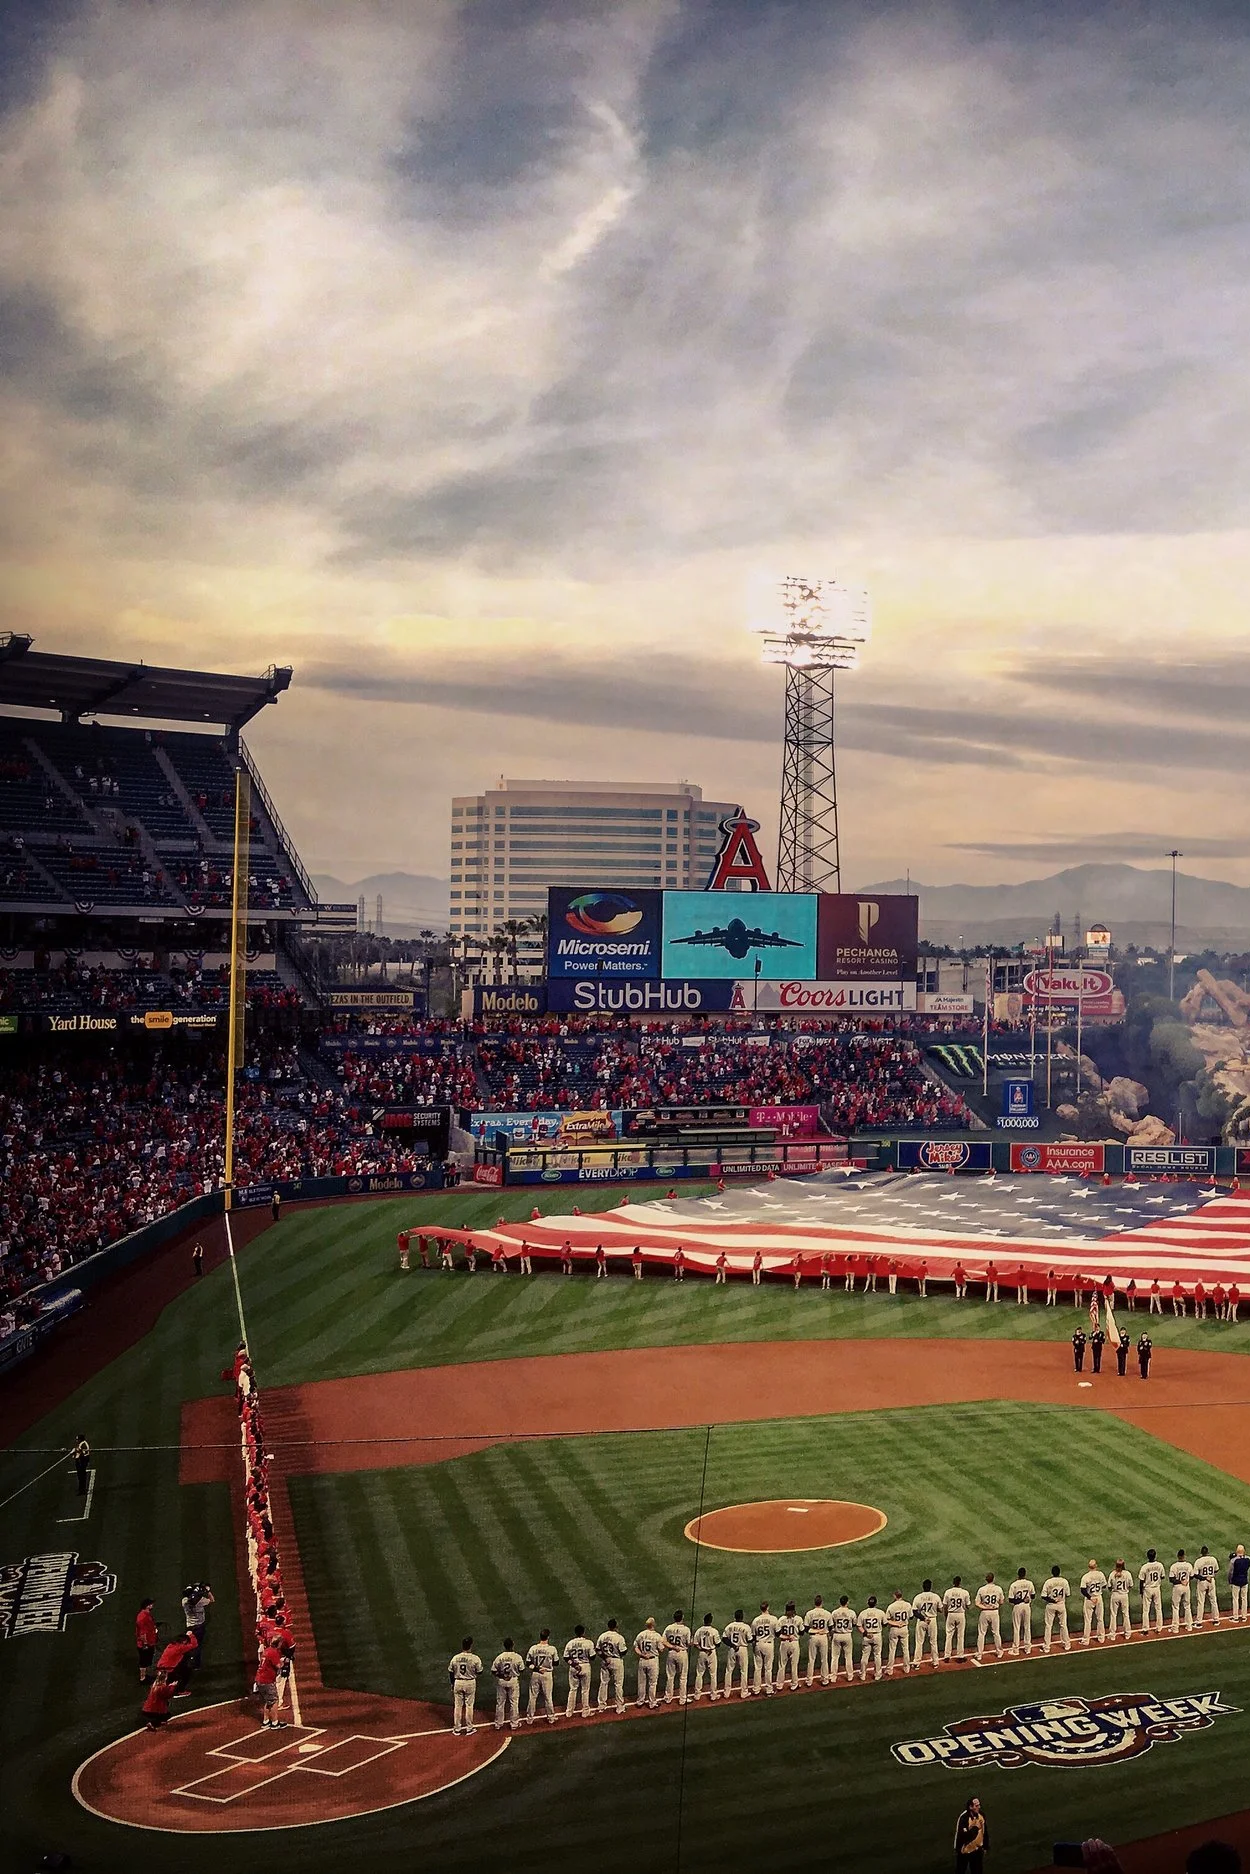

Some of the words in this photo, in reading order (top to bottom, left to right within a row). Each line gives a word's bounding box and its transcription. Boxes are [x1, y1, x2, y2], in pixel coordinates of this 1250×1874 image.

[836, 948, 898, 958] PECHANGA
[564, 960, 598, 970] Power
[1041, 977, 1099, 990] Yakult
[350, 995, 359, 1004] IN
[361, 995, 374, 1004] THE
[376, 995, 410, 1004] OUTFIELD
[574, 981, 702, 1009] StubHub
[780, 982, 847, 1007] Coors
[849, 989, 904, 1006] LIGHT
[482, 991, 538, 1011] Modelo
[49, 1015, 77, 1031] Yard
[80, 1016, 117, 1030] House
[130, 1015, 145, 1024] the
[148, 1014, 169, 1024] smile
[173, 1015, 216, 1026] generation
[997, 1119, 1039, 1129] $1,000,000
[926, 1142, 963, 1153] Jersey
[1046, 1146, 1094, 1157] Insurance
[722, 1164, 761, 1172] UNLIMITED
[783, 1162, 818, 1171] UNLIMITE
[1046, 1159, 1094, 1169] AAA.com
[369, 1177, 402, 1190] Modelo
[1202, 1565, 1214, 1575] 89
[1149, 1572, 1158, 1581] 18
[1090, 1583, 1101, 1593] 25
[1116, 1580, 1126, 1590] 21
[1052, 1588, 1064, 1598] 34
[949, 1598, 961, 1609] 39
[984, 1595, 997, 1605] 38
[921, 1603, 933, 1613] 47
[895, 1611, 907, 1621] 50
[812, 1619, 825, 1629] 58
[836, 1619, 849, 1629] 53
[865, 1619, 878, 1629] 52
[757, 1625, 770, 1636] 65
[732, 1633, 739, 1643] 5
[641, 1640, 652, 1651] 15
[571, 1648, 583, 1659] 22
[535, 1656, 546, 1667] 17
[460, 1663, 467, 1675] 9
[896, 1716, 1102, 1763] OPENING
[1099, 1695, 1230, 1730] WEEK
